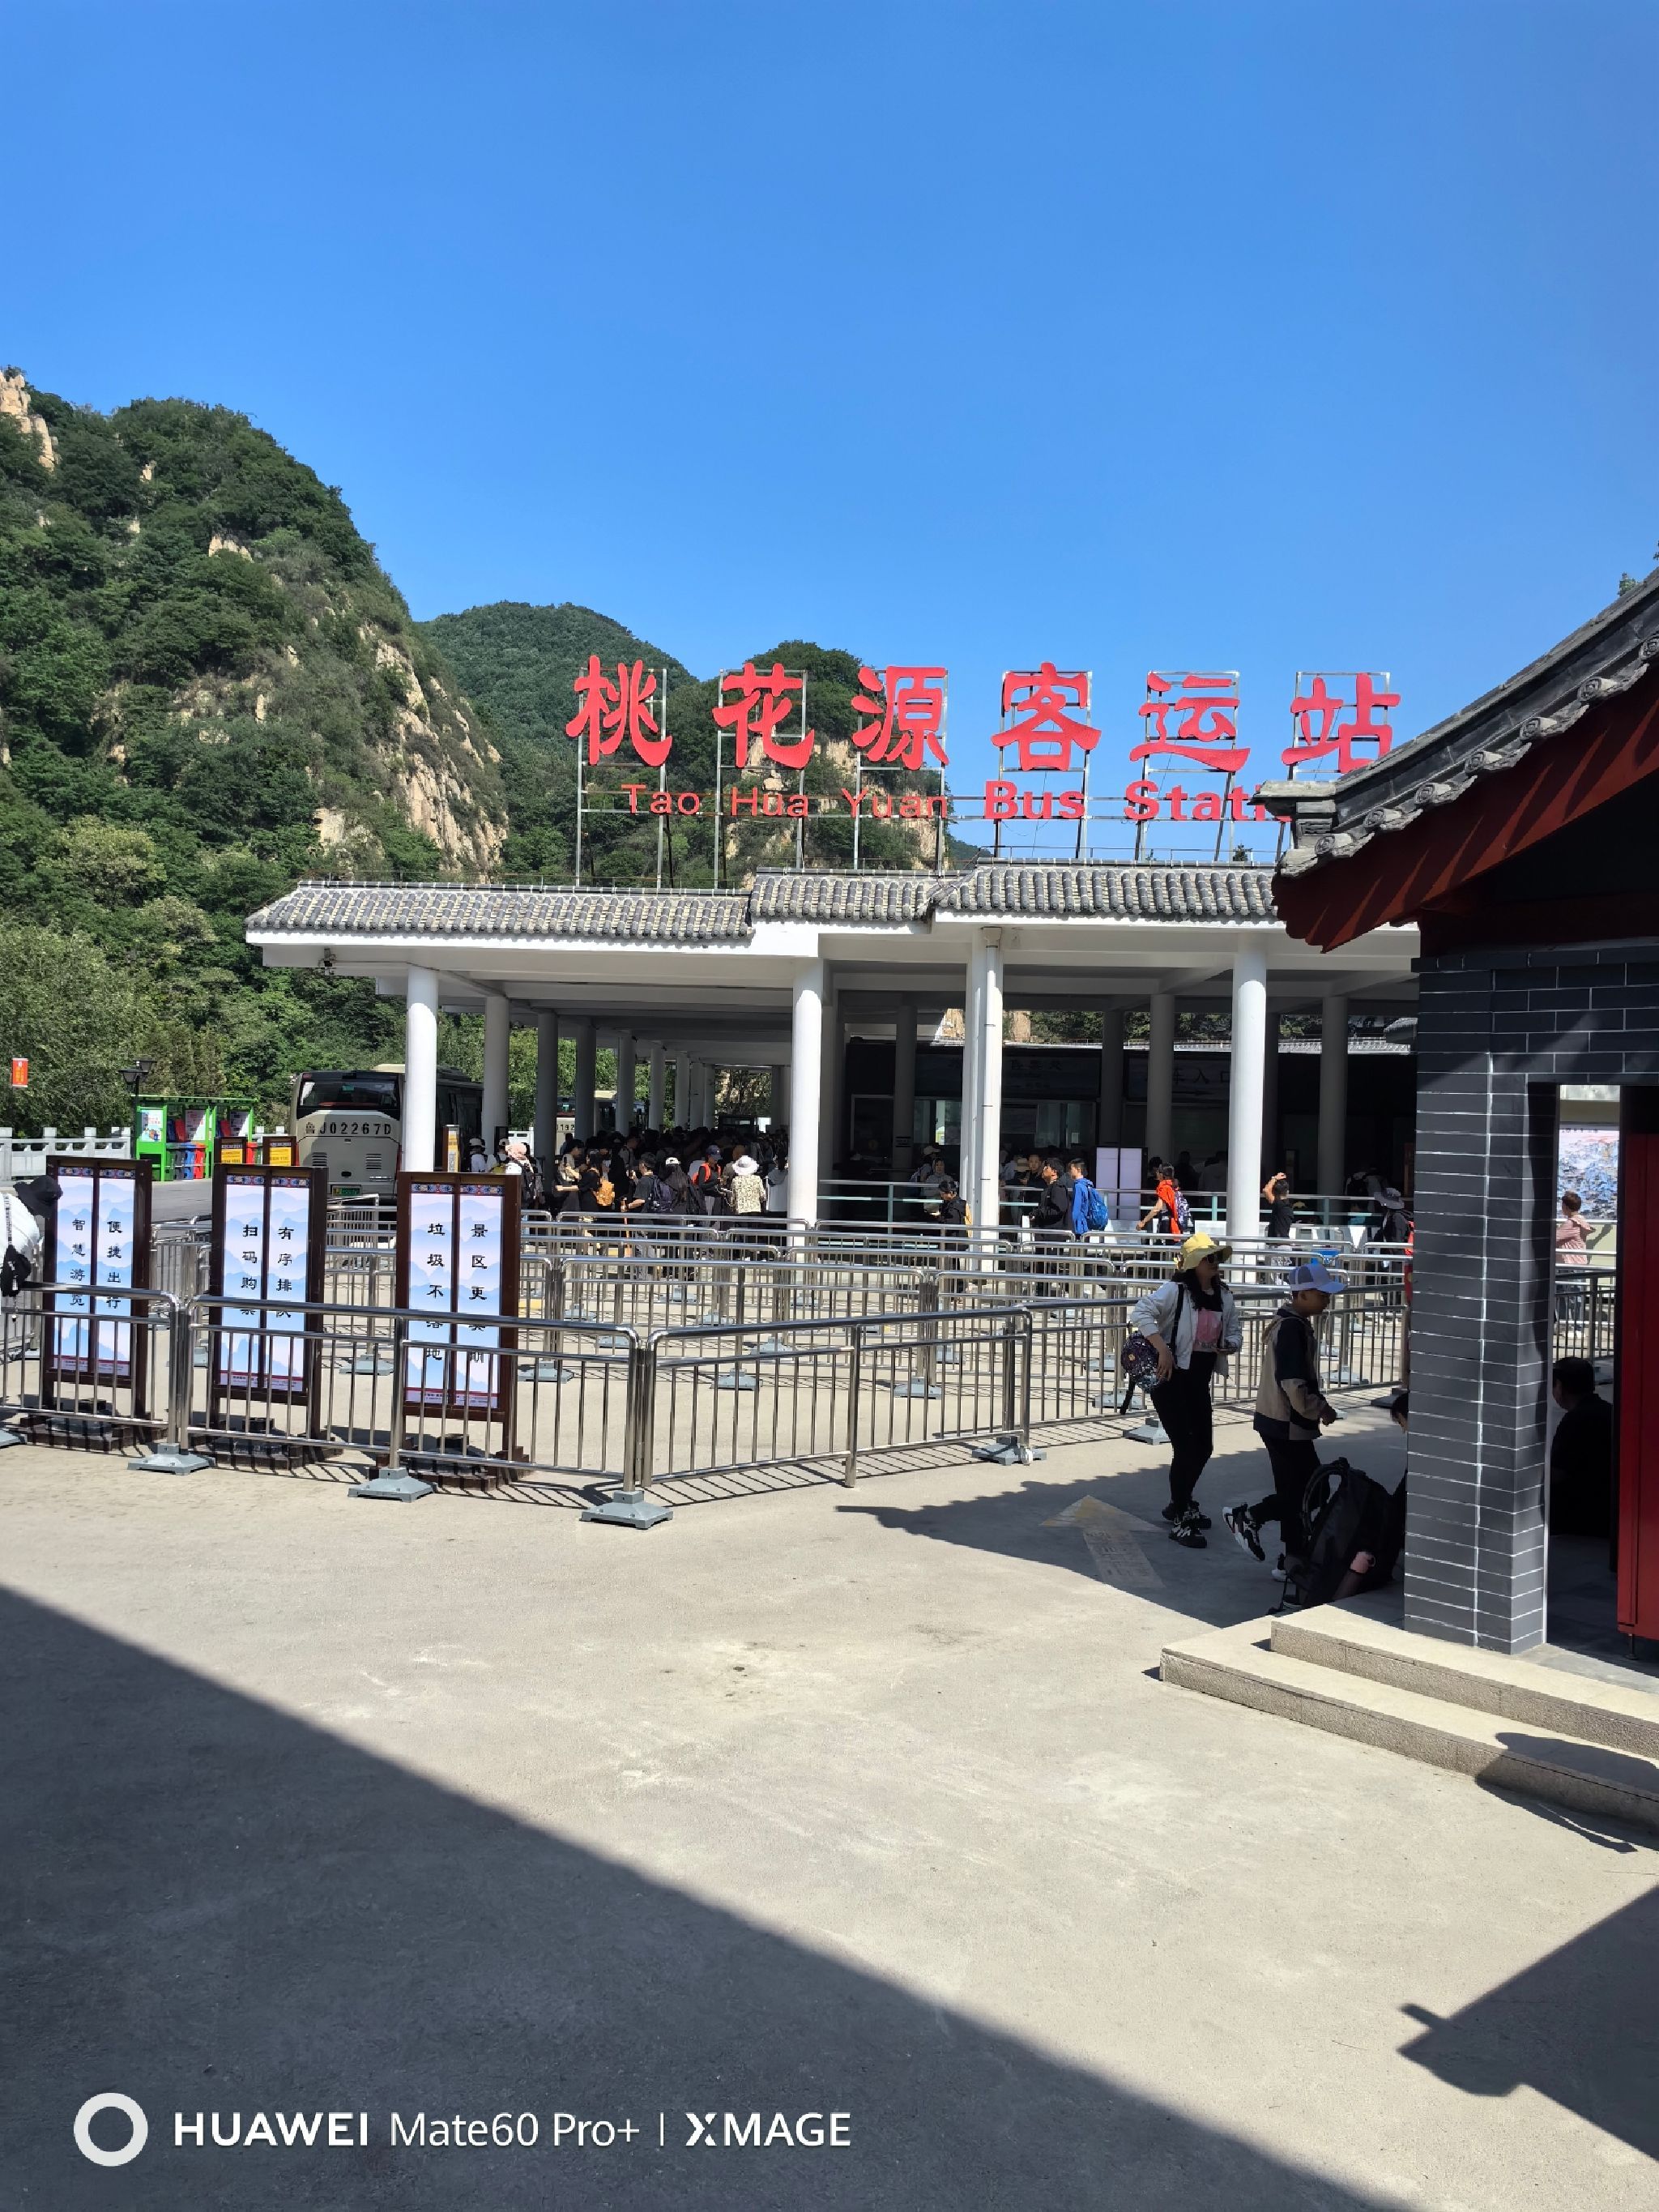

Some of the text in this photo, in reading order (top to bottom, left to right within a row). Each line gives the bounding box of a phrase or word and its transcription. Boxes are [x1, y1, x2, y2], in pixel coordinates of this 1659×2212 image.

[565, 655, 1401, 774] 桃花源客运站
[621, 780, 1293, 822] Tao Hua Yuan Bus Stati
[70, 1219, 86, 1306] 智慧游览
[105, 1220, 123, 1309] 便捷出行
